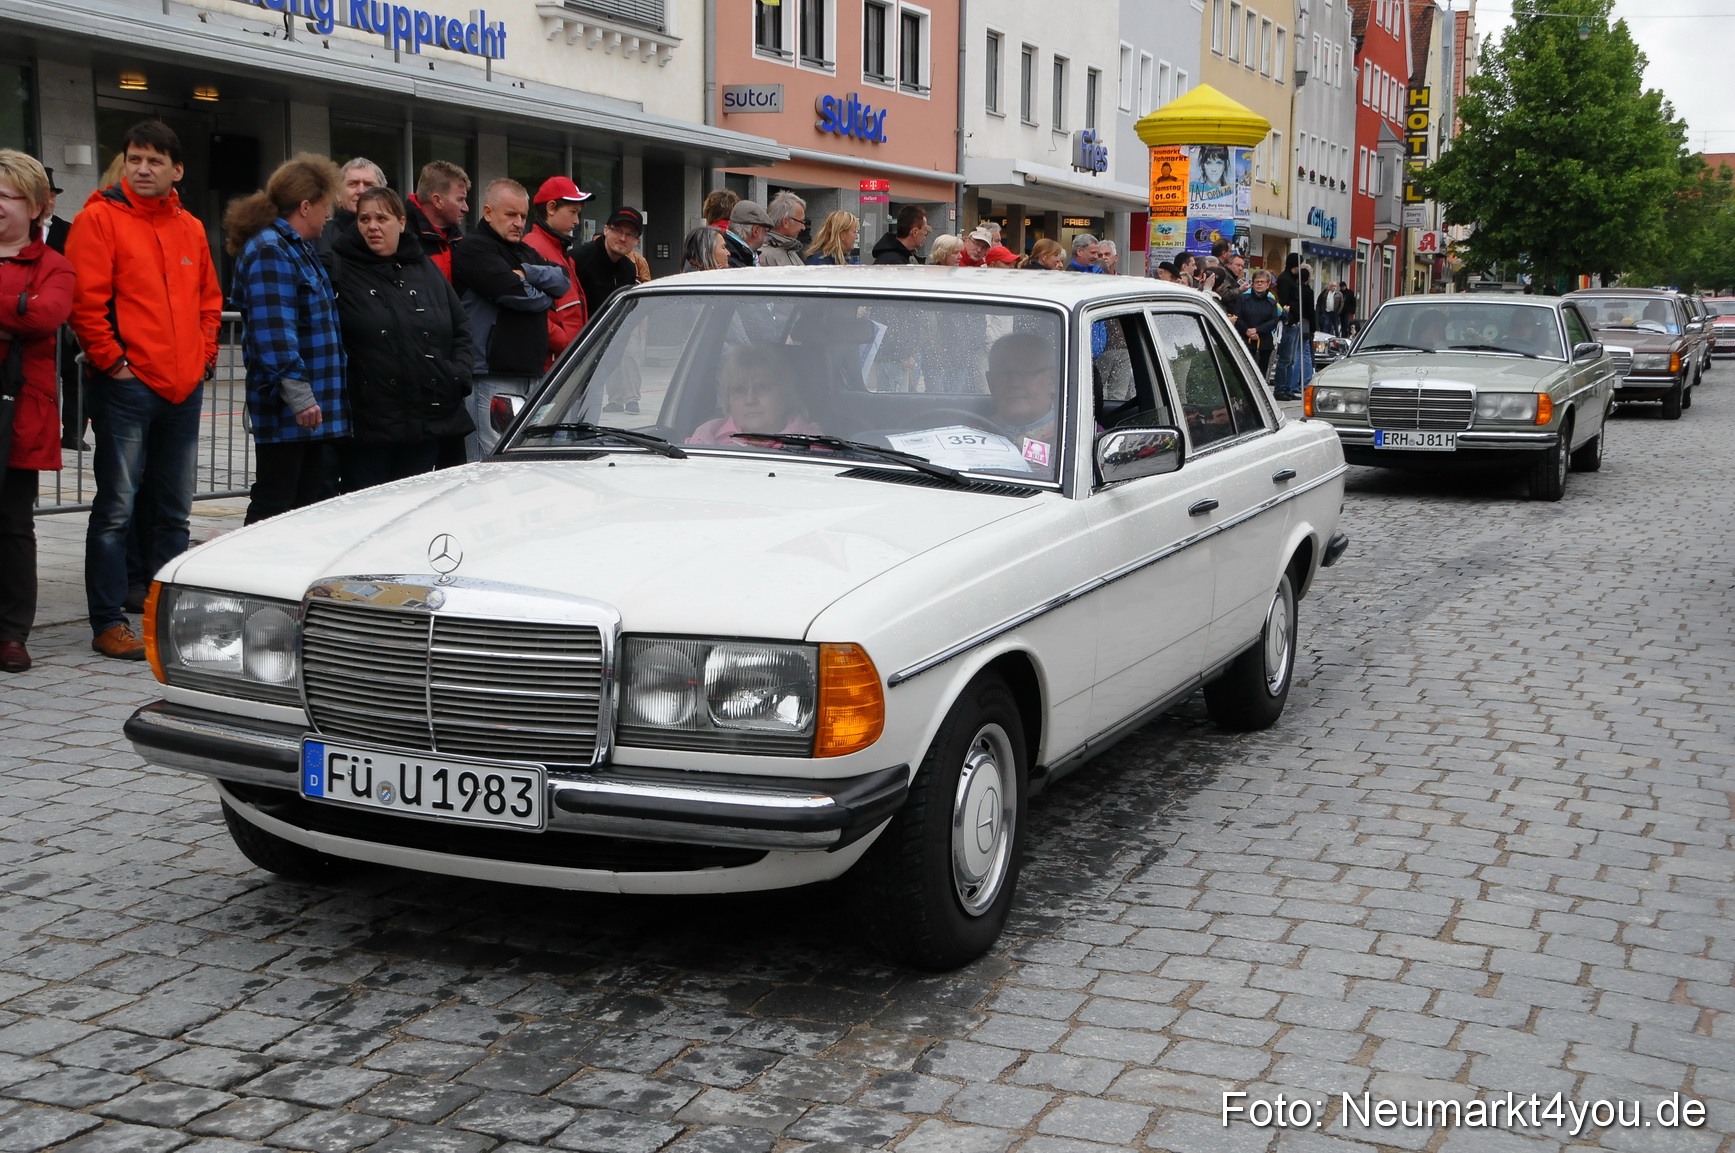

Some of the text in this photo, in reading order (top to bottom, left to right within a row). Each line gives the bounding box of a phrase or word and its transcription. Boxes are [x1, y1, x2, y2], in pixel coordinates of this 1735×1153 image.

[350, 0, 506, 59] Rupprecht
[1406, 88, 1429, 201] HOTEL
[1155, 192, 1180, 201] 01.06.
[1063, 218, 1091, 226] FRIES
[948, 435, 987, 445] 357
[1383, 433, 1408, 446] ERH
[310, 774, 319, 787] D
[328, 752, 372, 799] FÜ
